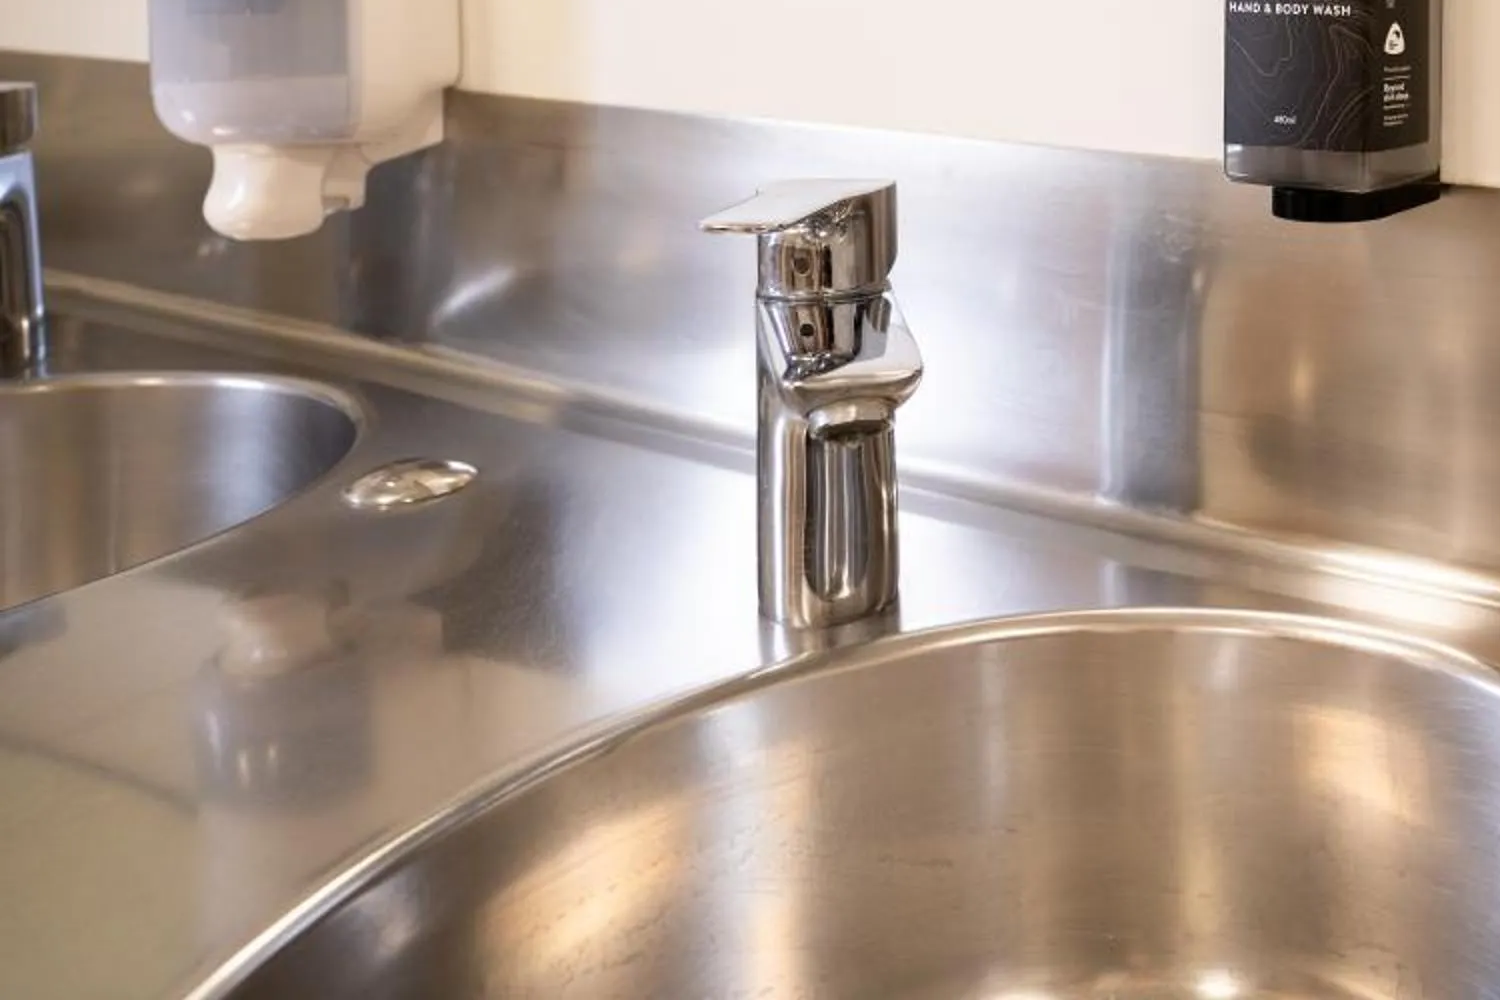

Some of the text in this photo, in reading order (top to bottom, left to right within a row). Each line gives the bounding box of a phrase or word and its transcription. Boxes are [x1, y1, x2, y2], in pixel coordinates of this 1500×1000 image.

[1229, 1, 1351, 17] HAND & BODY WASH
